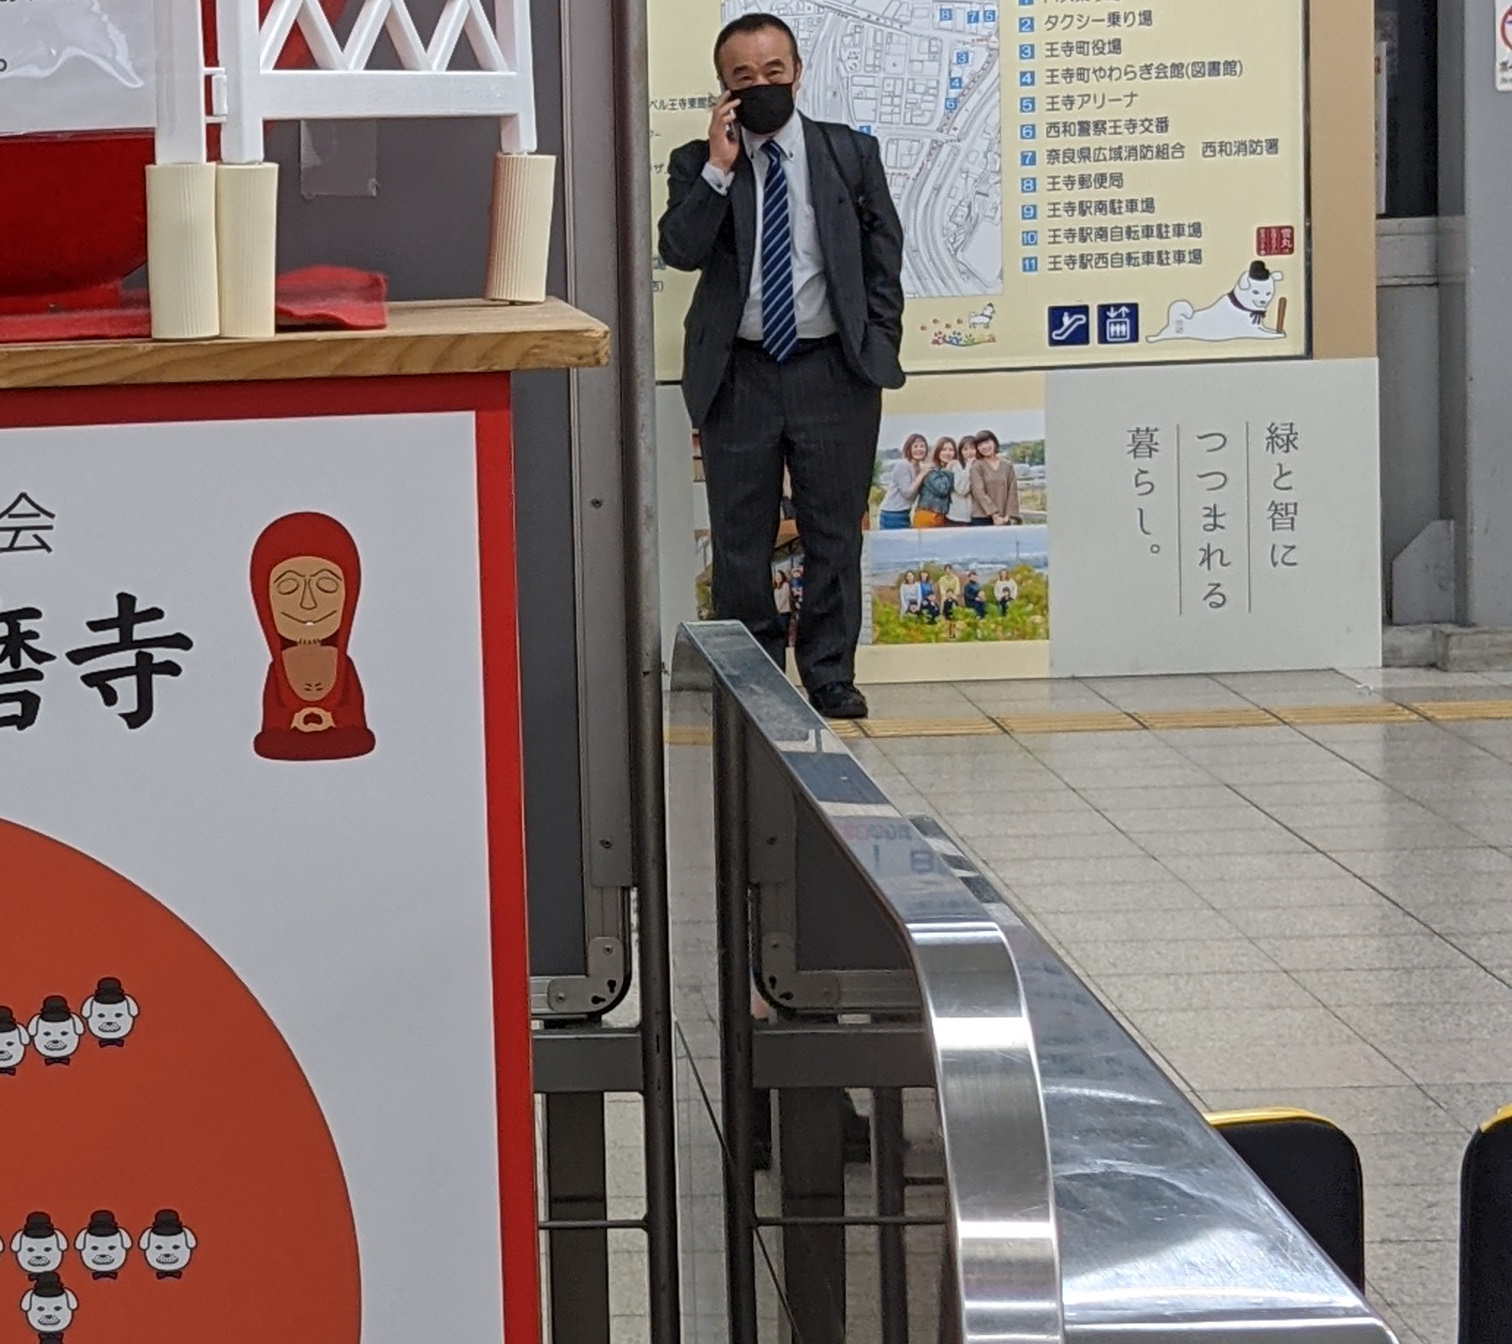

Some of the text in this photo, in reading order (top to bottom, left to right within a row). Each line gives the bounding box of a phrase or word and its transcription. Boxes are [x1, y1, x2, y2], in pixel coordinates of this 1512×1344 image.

[1044, 10, 1153, 30] タクシー乗り場
[1044, 39, 1122, 59] 王寺町役場
[1045, 91, 1139, 112] 王寺アリーナ
[1046, 173, 1124, 193] 王寺郵便局
[1047, 198, 1155, 219] 王寺駅南駐車場
[1125, 425, 1162, 556] 暮らし。
[1264, 420, 1300, 569] 緑と智に
[1196, 429, 1232, 611] つつまれる
